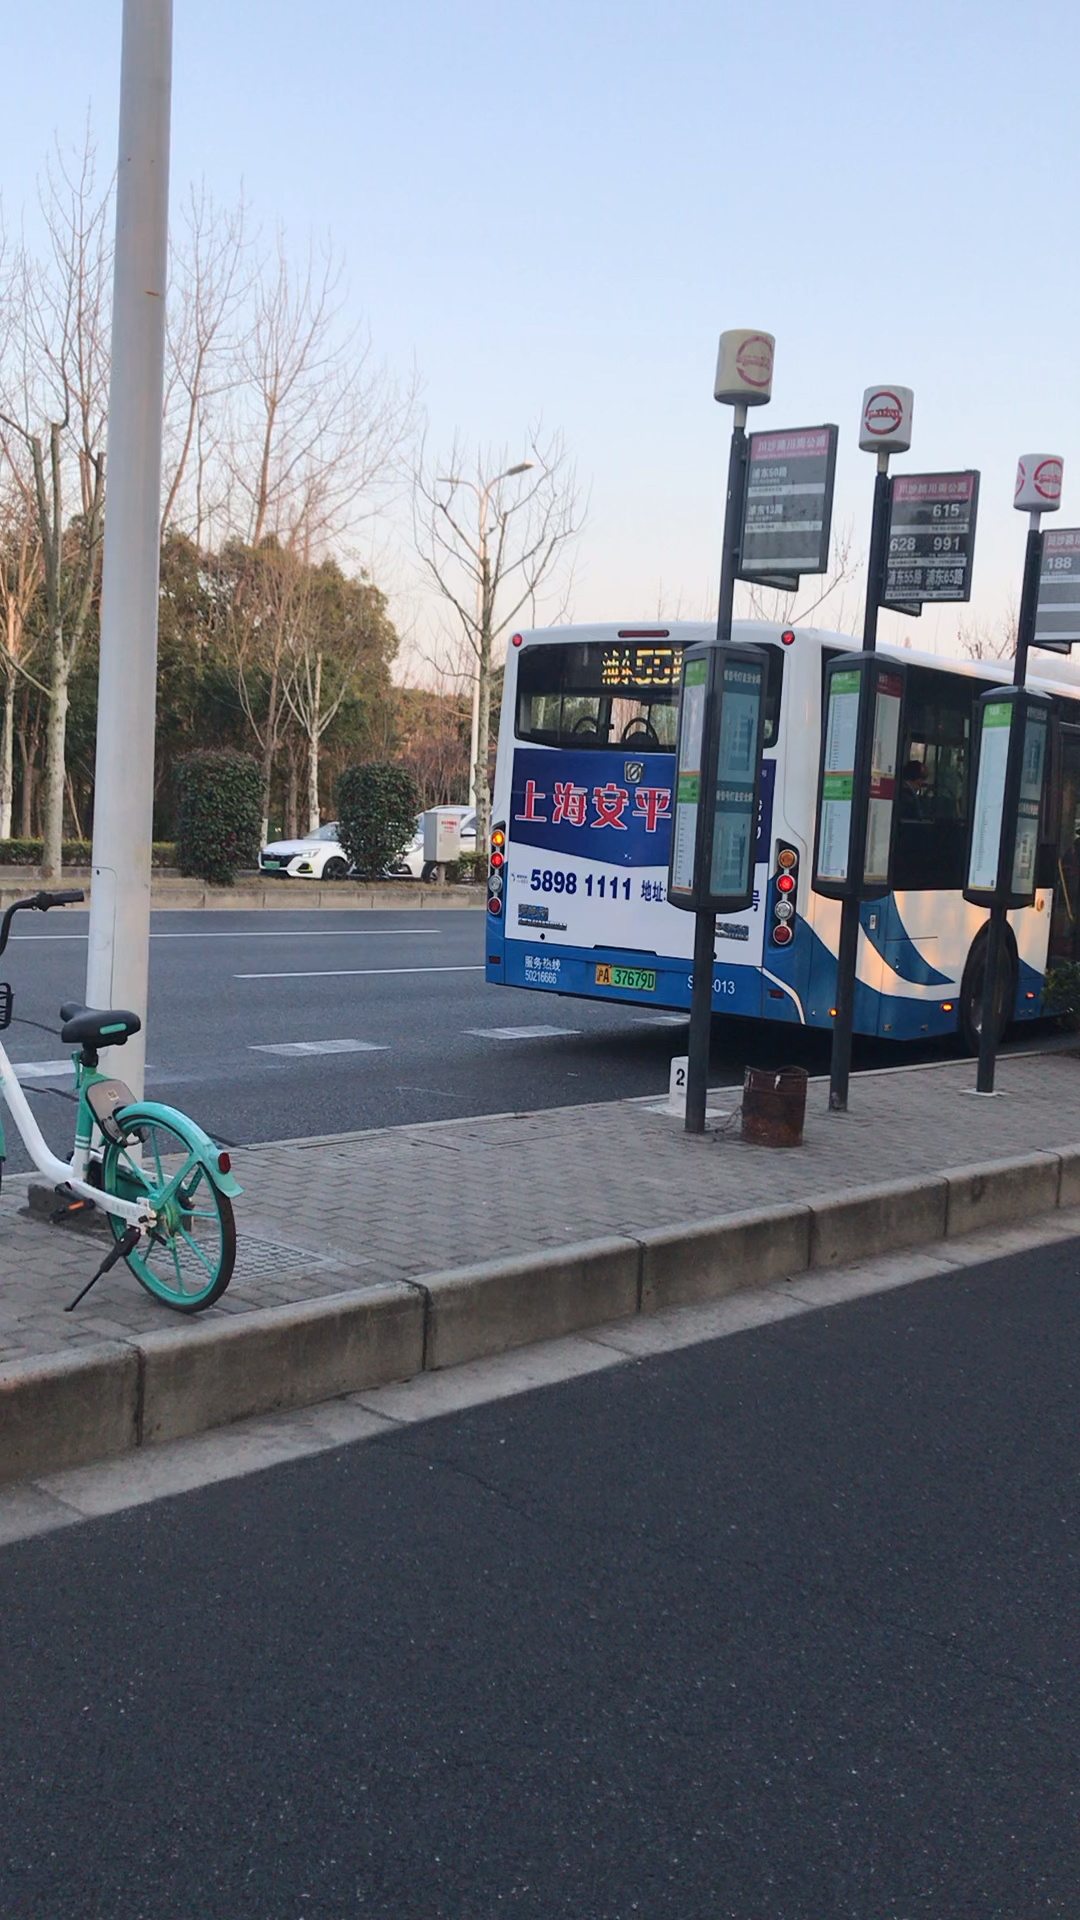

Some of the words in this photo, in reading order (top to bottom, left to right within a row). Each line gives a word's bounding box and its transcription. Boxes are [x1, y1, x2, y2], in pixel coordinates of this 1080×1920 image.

[932, 503, 960, 517] 615
[889, 536, 916, 552] 628
[933, 536, 960, 551] 991
[1047, 556, 1072, 569] 188
[887, 569, 922, 585] 浦东55路
[925, 568, 963, 586] 浦东65路
[515, 779, 672, 832] 上海安平
[530, 868, 577, 895] 5898
[585, 874, 631, 900] 1111
[525, 956, 561, 975] 服务热线
[525, 970, 557, 985] 50216666
[676, 1068, 686, 1086] 2
